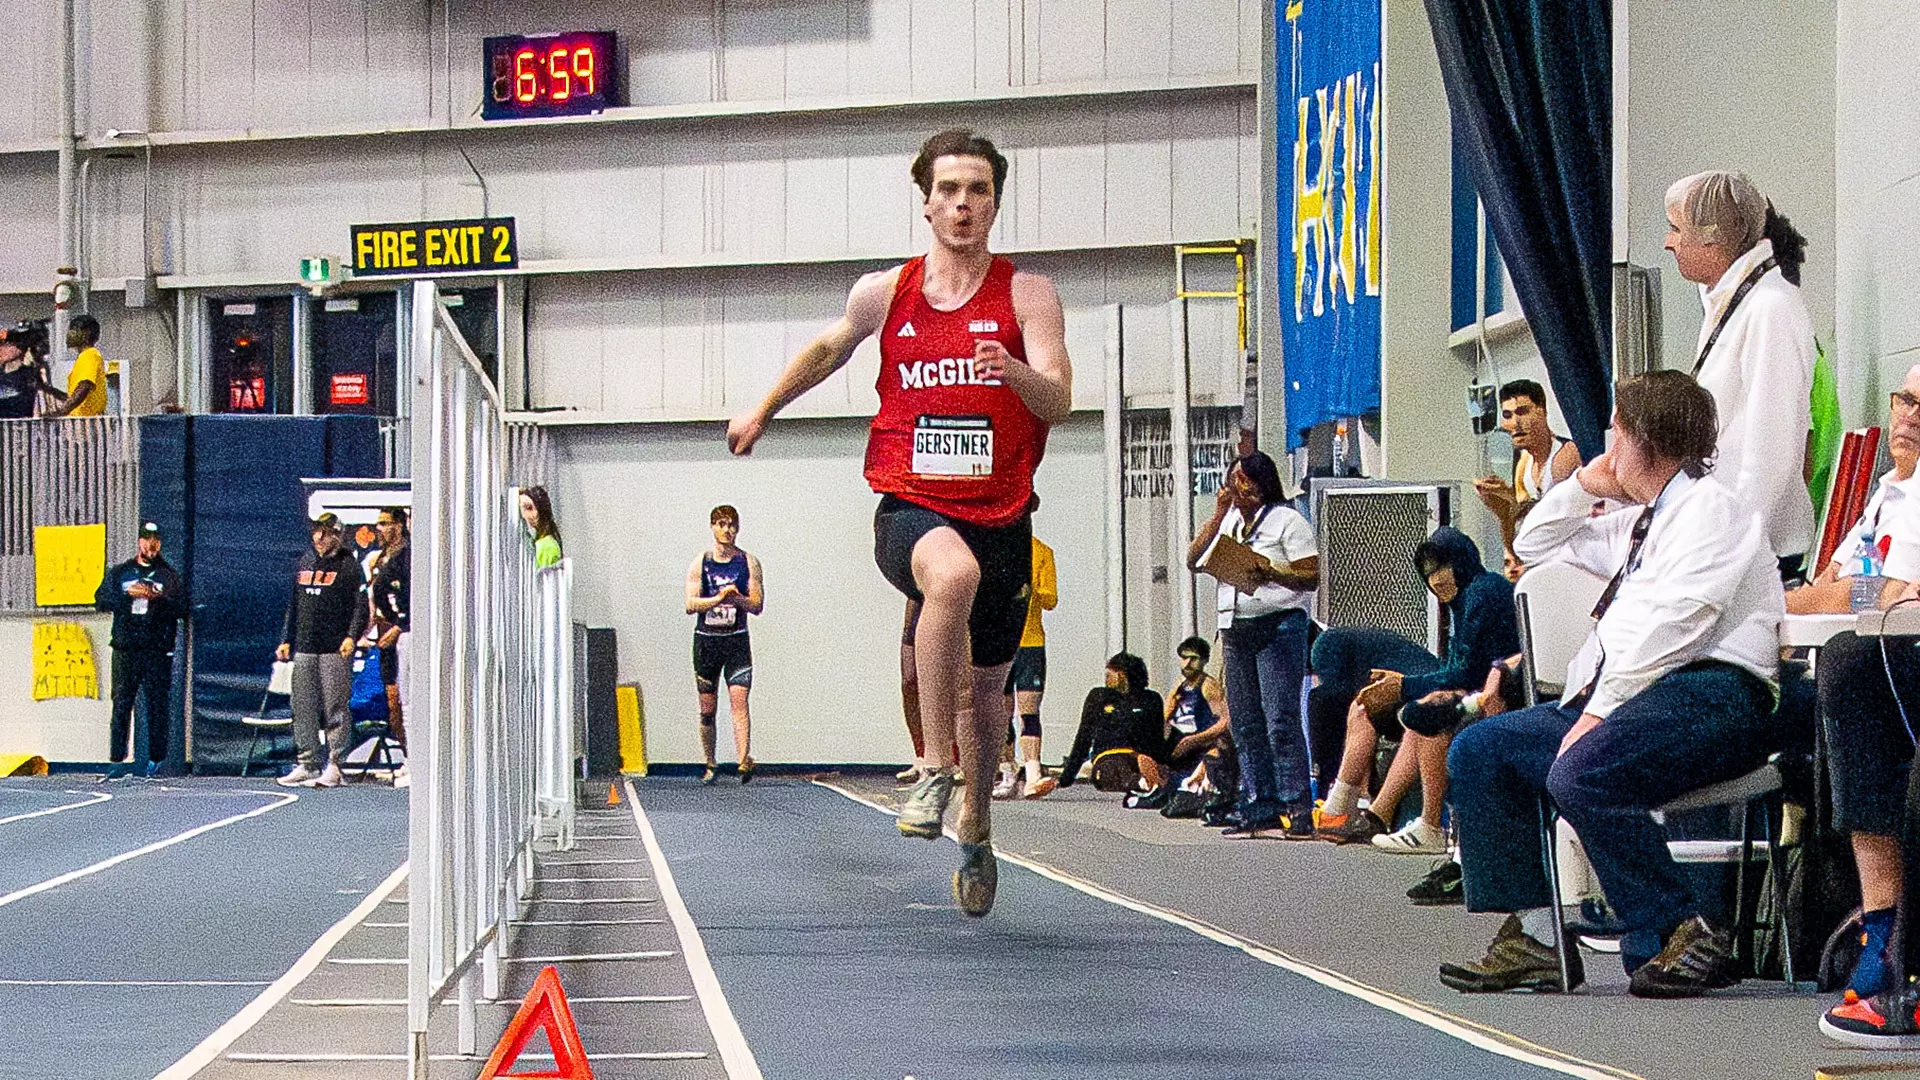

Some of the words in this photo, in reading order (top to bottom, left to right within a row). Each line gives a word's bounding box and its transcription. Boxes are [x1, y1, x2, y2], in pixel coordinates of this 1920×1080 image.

[516, 47, 594, 102] 6:59
[356, 230, 419, 270] FIRE
[425, 226, 484, 266] EXIT
[492, 226, 512, 263] 2
[898, 358, 1002, 390] McGIL
[916, 432, 990, 457] GERSTNER
